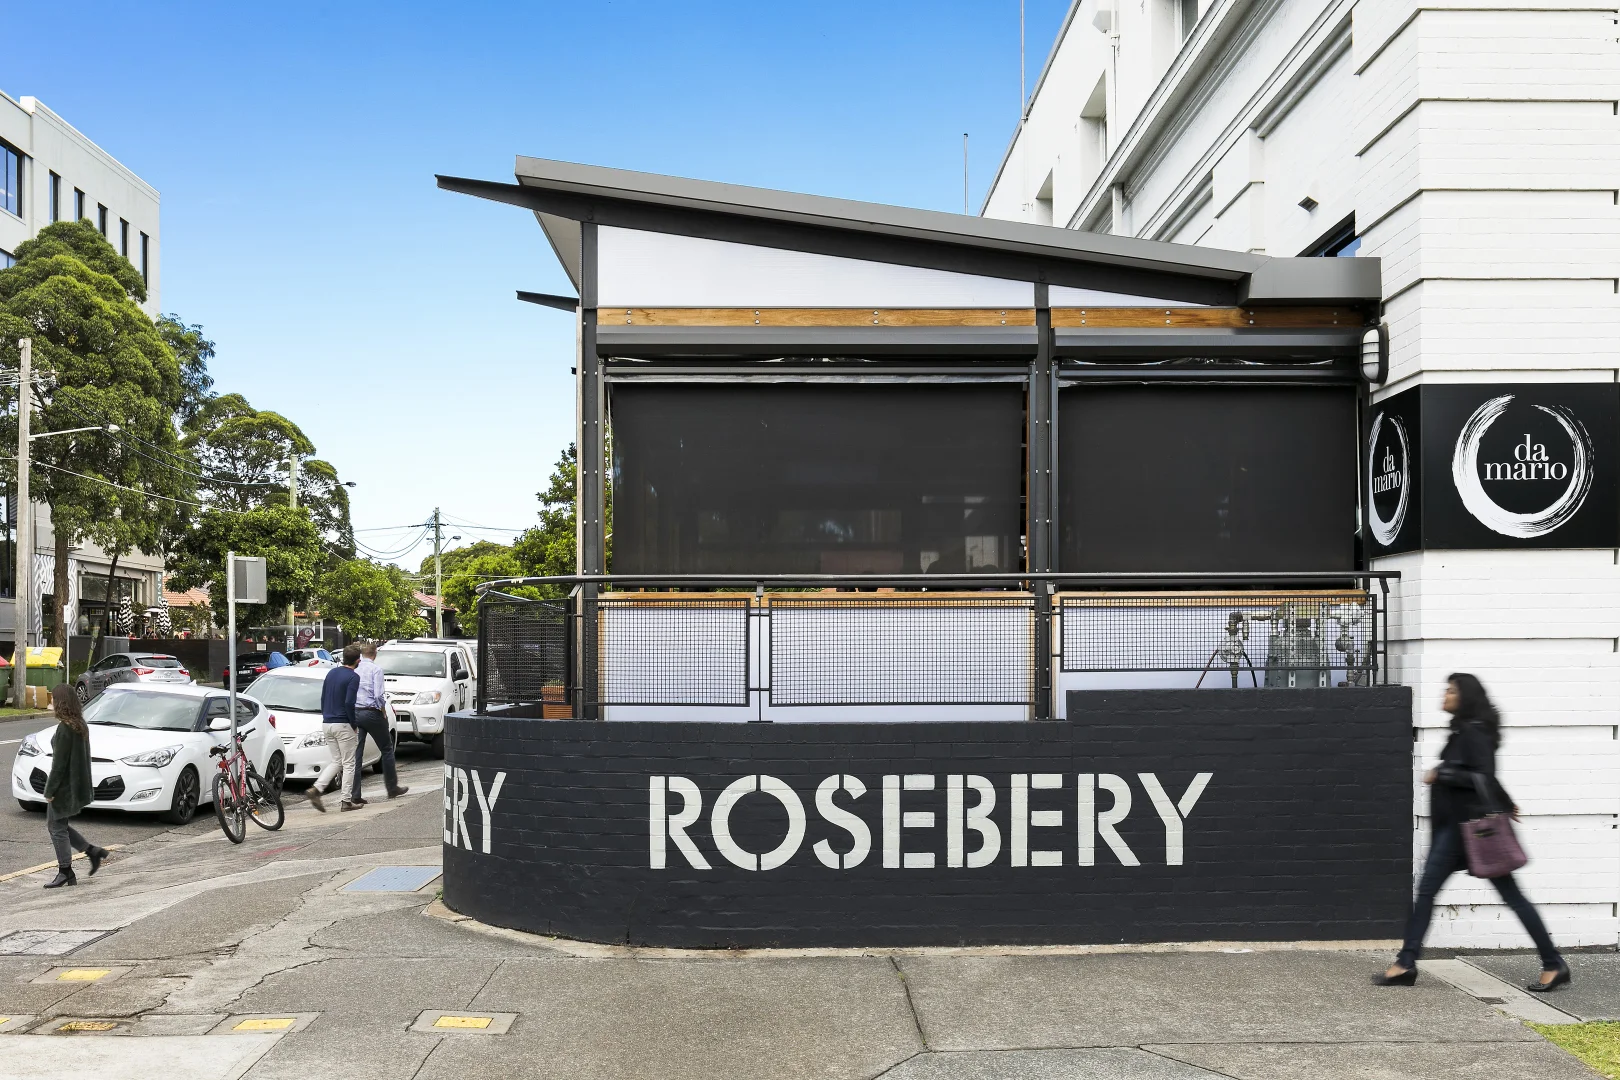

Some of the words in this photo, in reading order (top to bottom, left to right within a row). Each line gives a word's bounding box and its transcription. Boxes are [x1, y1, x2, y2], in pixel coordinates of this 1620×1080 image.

[1383, 446, 1395, 473] da
[1514, 433, 1549, 462] da
[1374, 470, 1402, 494] mario
[1484, 462, 1568, 481] mario
[649, 772, 1214, 872] ROSEBERY
